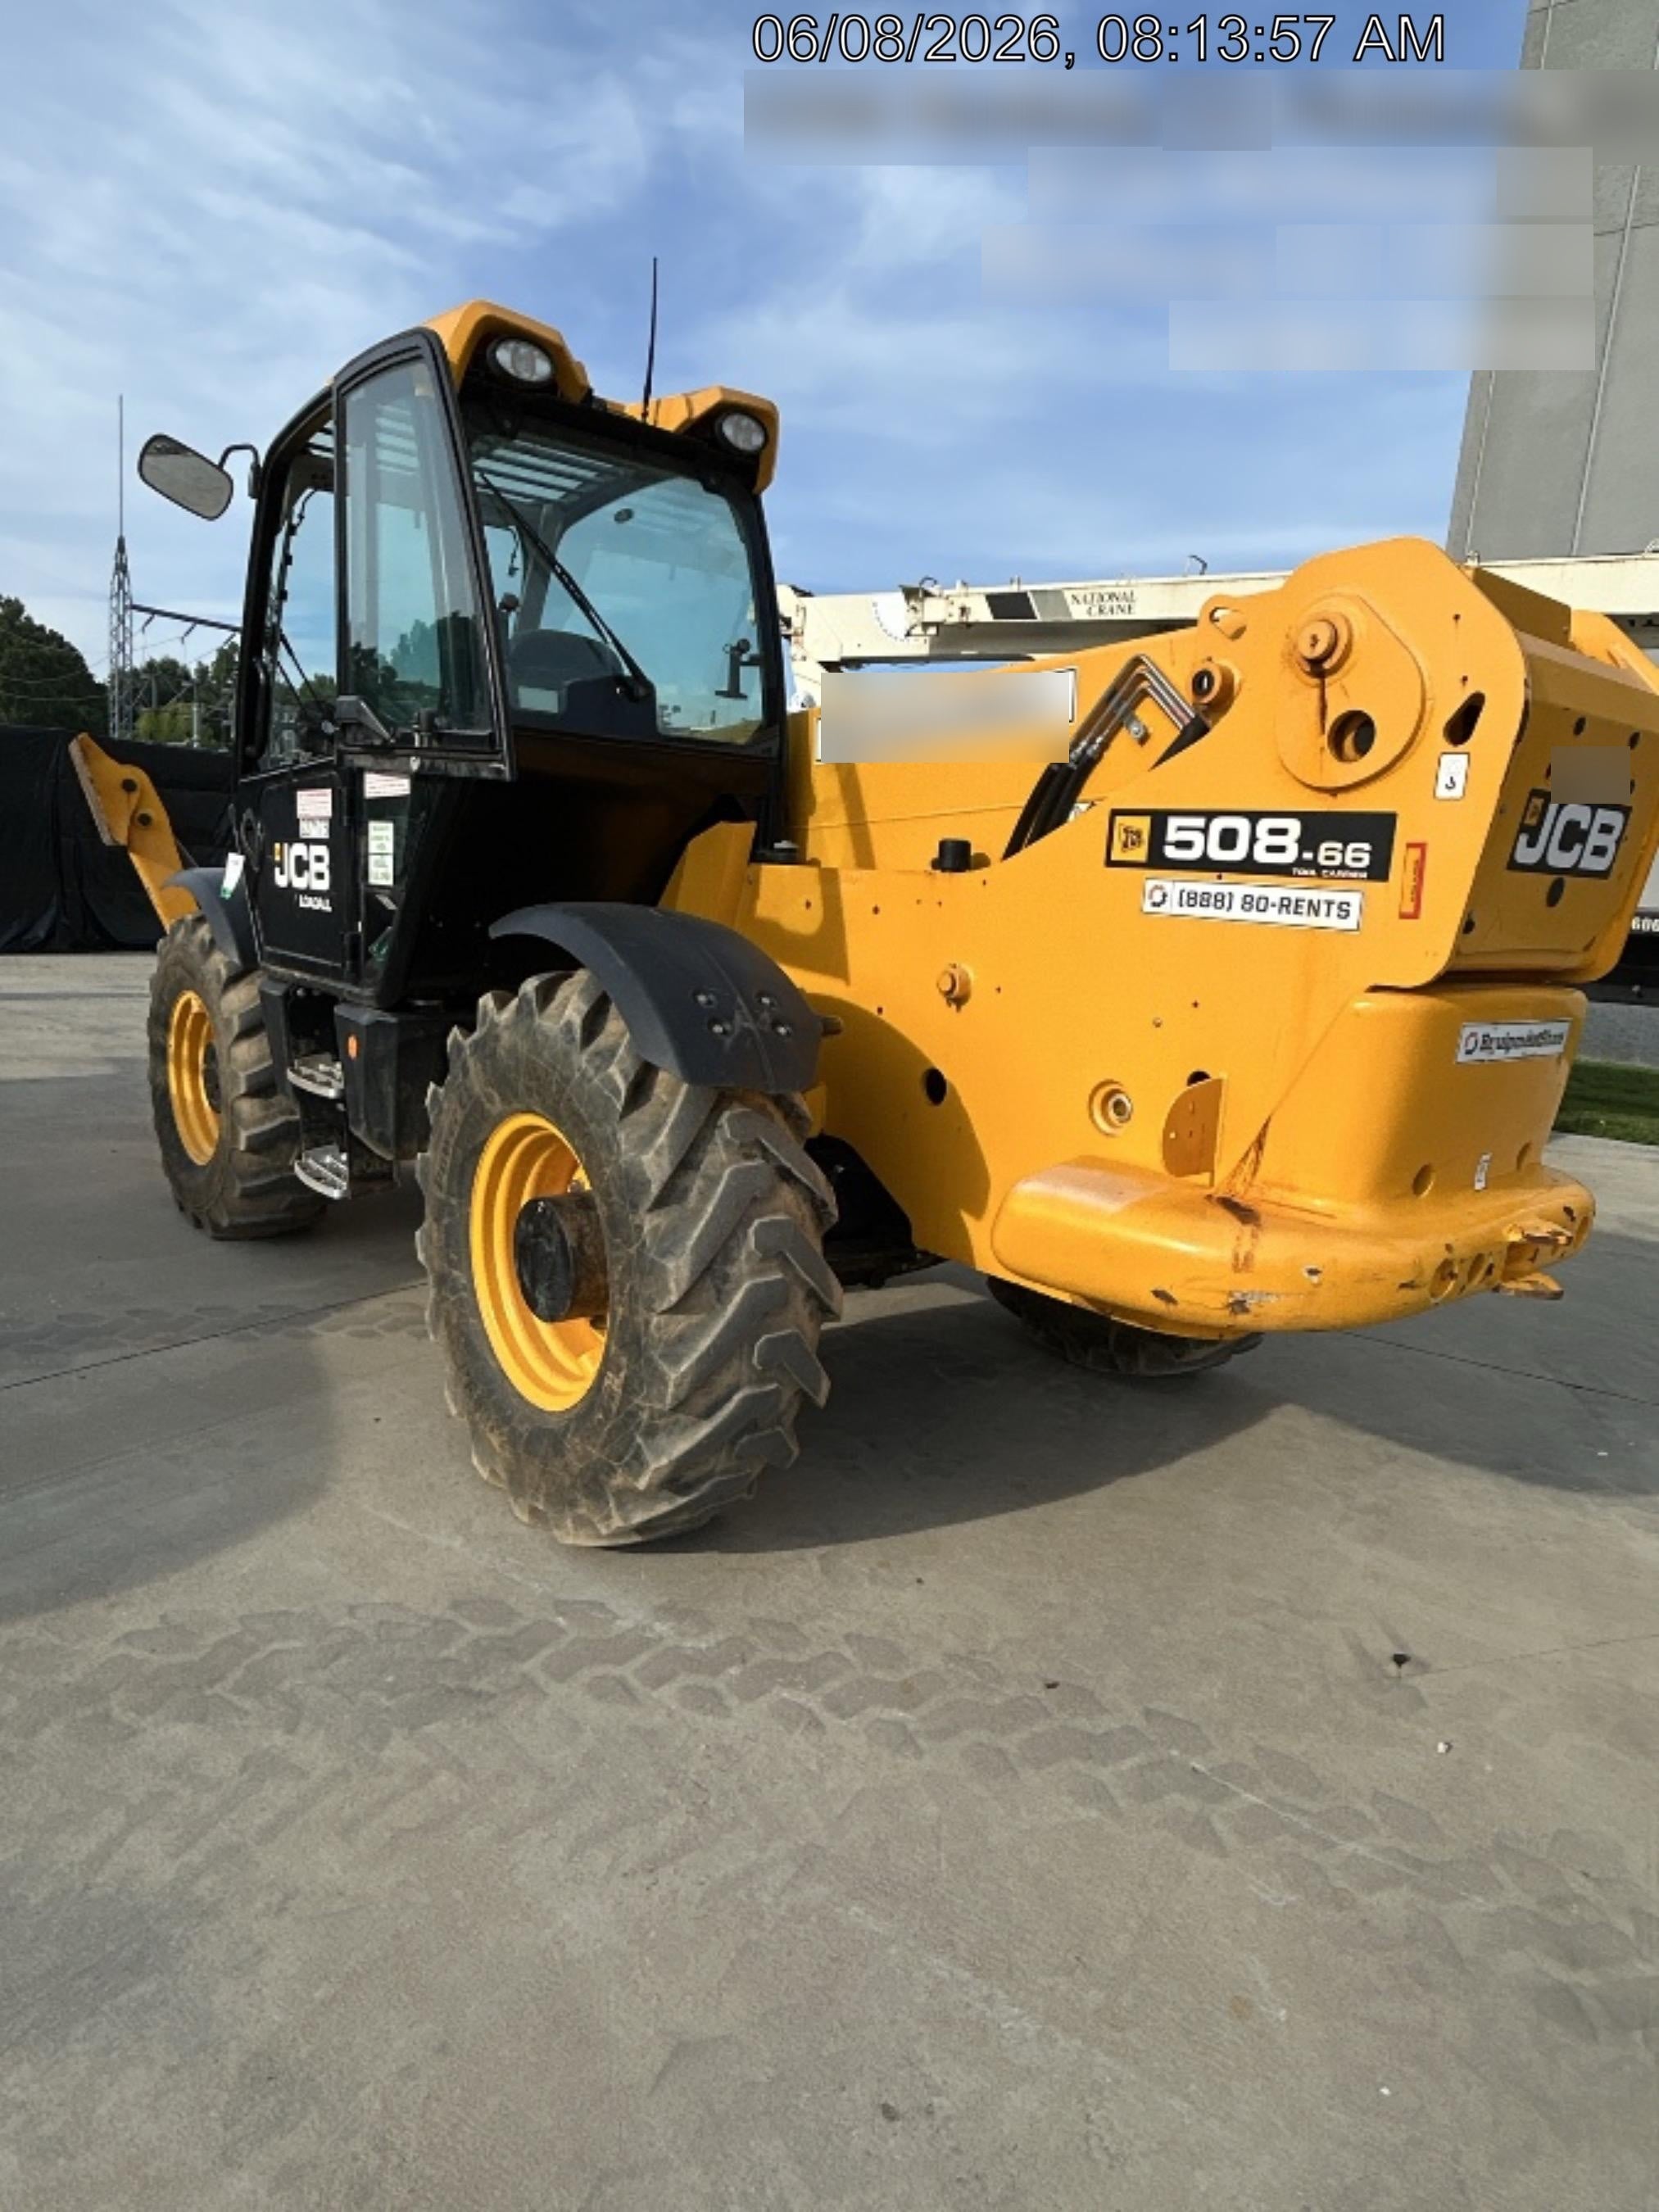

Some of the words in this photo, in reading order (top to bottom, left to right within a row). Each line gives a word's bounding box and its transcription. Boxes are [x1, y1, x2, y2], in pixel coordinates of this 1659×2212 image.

[1071, 591, 1135, 605] NATIONAL
[1086, 604, 1135, 617] CRANE
[1514, 803, 1625, 872] JCB
[274, 842, 329, 891] JCB
[1240, 894, 1352, 921] 80-RENTS
